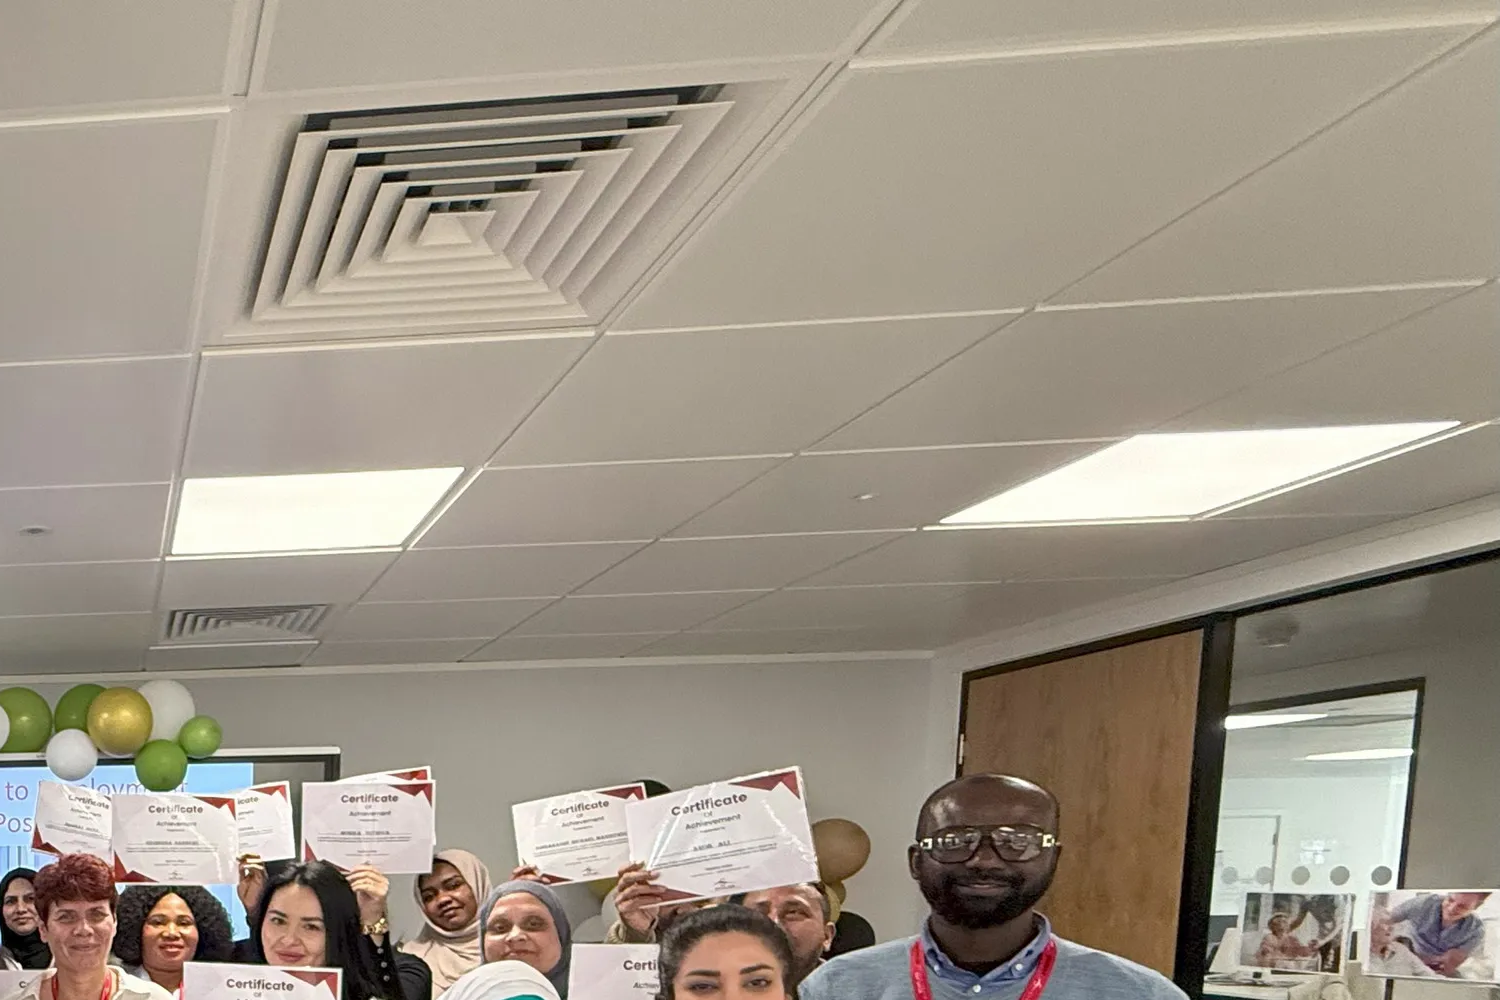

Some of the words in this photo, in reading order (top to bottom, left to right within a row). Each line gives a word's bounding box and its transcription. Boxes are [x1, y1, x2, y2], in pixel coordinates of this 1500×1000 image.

[5, 781, 29, 801] to
[341, 793, 399, 804] Certificate
[148, 804, 204, 814] Certificate
[551, 800, 609, 816] Certificate
[671, 793, 748, 817] Certificate
[226, 978, 295, 992] Certificate
